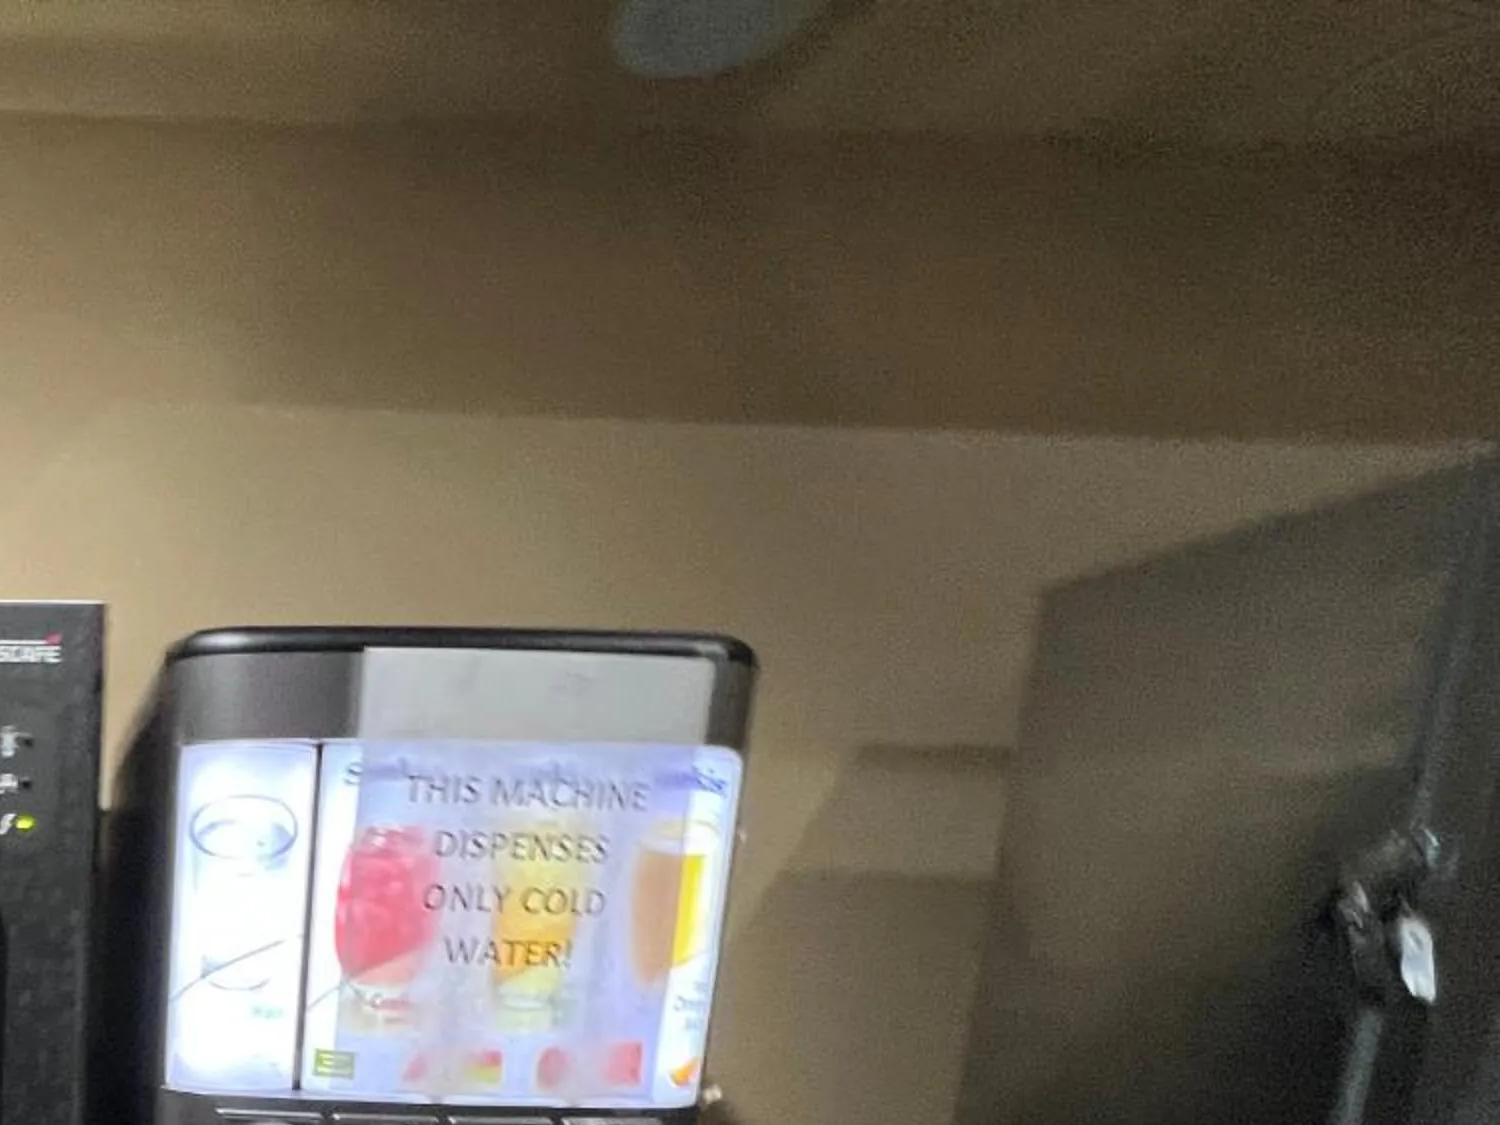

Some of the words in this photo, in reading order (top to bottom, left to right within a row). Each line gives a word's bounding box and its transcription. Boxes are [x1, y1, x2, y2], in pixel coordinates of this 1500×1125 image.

[407, 774, 482, 804] THIS
[490, 778, 650, 811] MACHINE
[435, 831, 611, 863] DISPENSES
[423, 884, 513, 913] ONLY
[521, 887, 606, 917] COLD
[444, 938, 572, 969] WATER!
